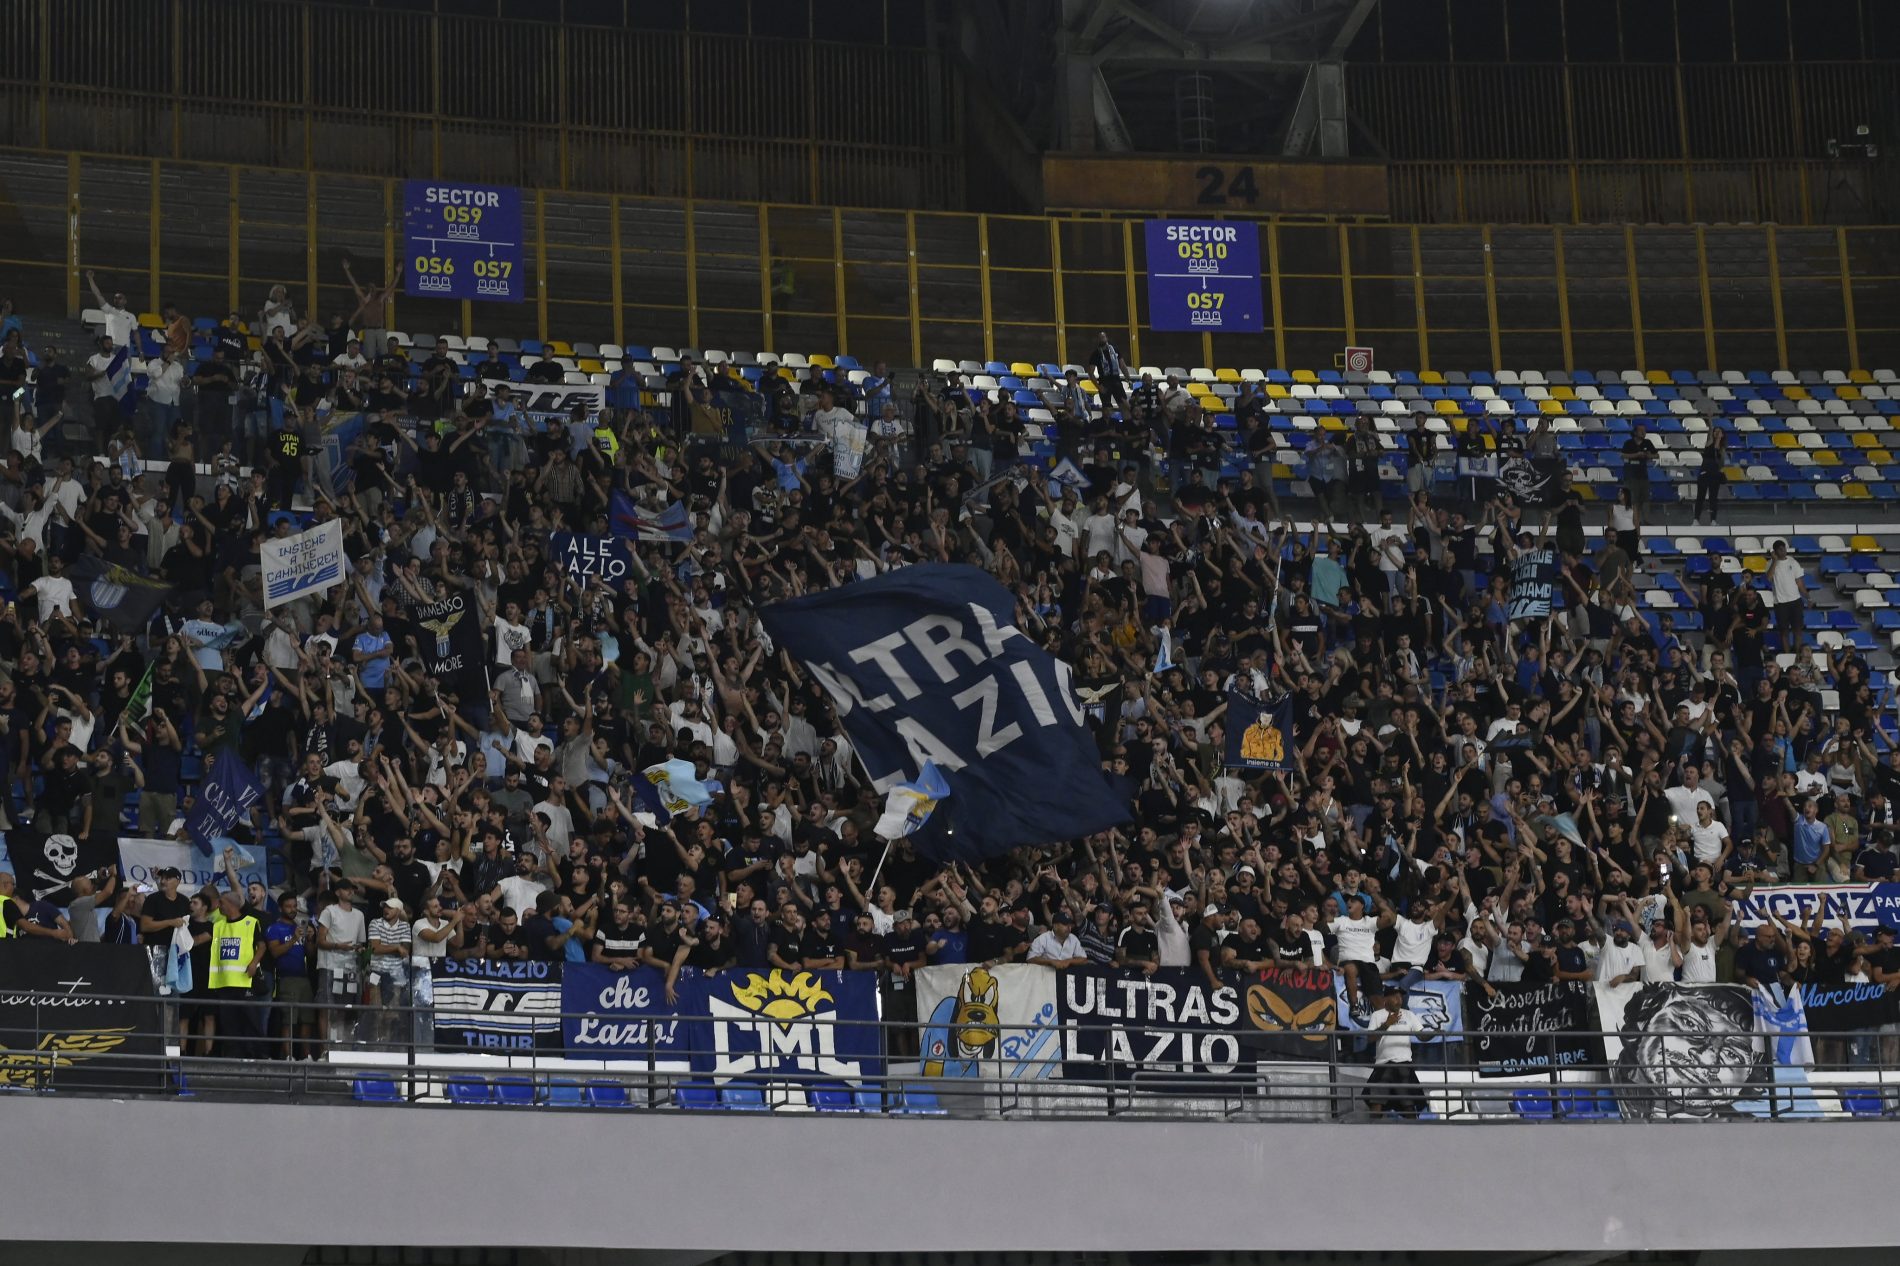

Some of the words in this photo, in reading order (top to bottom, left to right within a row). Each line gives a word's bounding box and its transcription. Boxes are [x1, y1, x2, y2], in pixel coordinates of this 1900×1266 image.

[426, 187, 499, 207] SECTOR
[1195, 166, 1260, 204] 24
[1166, 226, 1237, 242] SECTOR
[282, 442, 298, 456] 45
[279, 533, 326, 557] INSIEME
[290, 556, 297, 565] A
[302, 549, 317, 559] TE
[222, 949, 236, 957] 716
[598, 975, 650, 1008] che
[1066, 974, 1239, 1025] ULTRAS
[1800, 982, 1887, 1008] Marcolino
[574, 1012, 679, 1046] Lazio!
[1066, 1018, 1239, 1074] LAZIO
